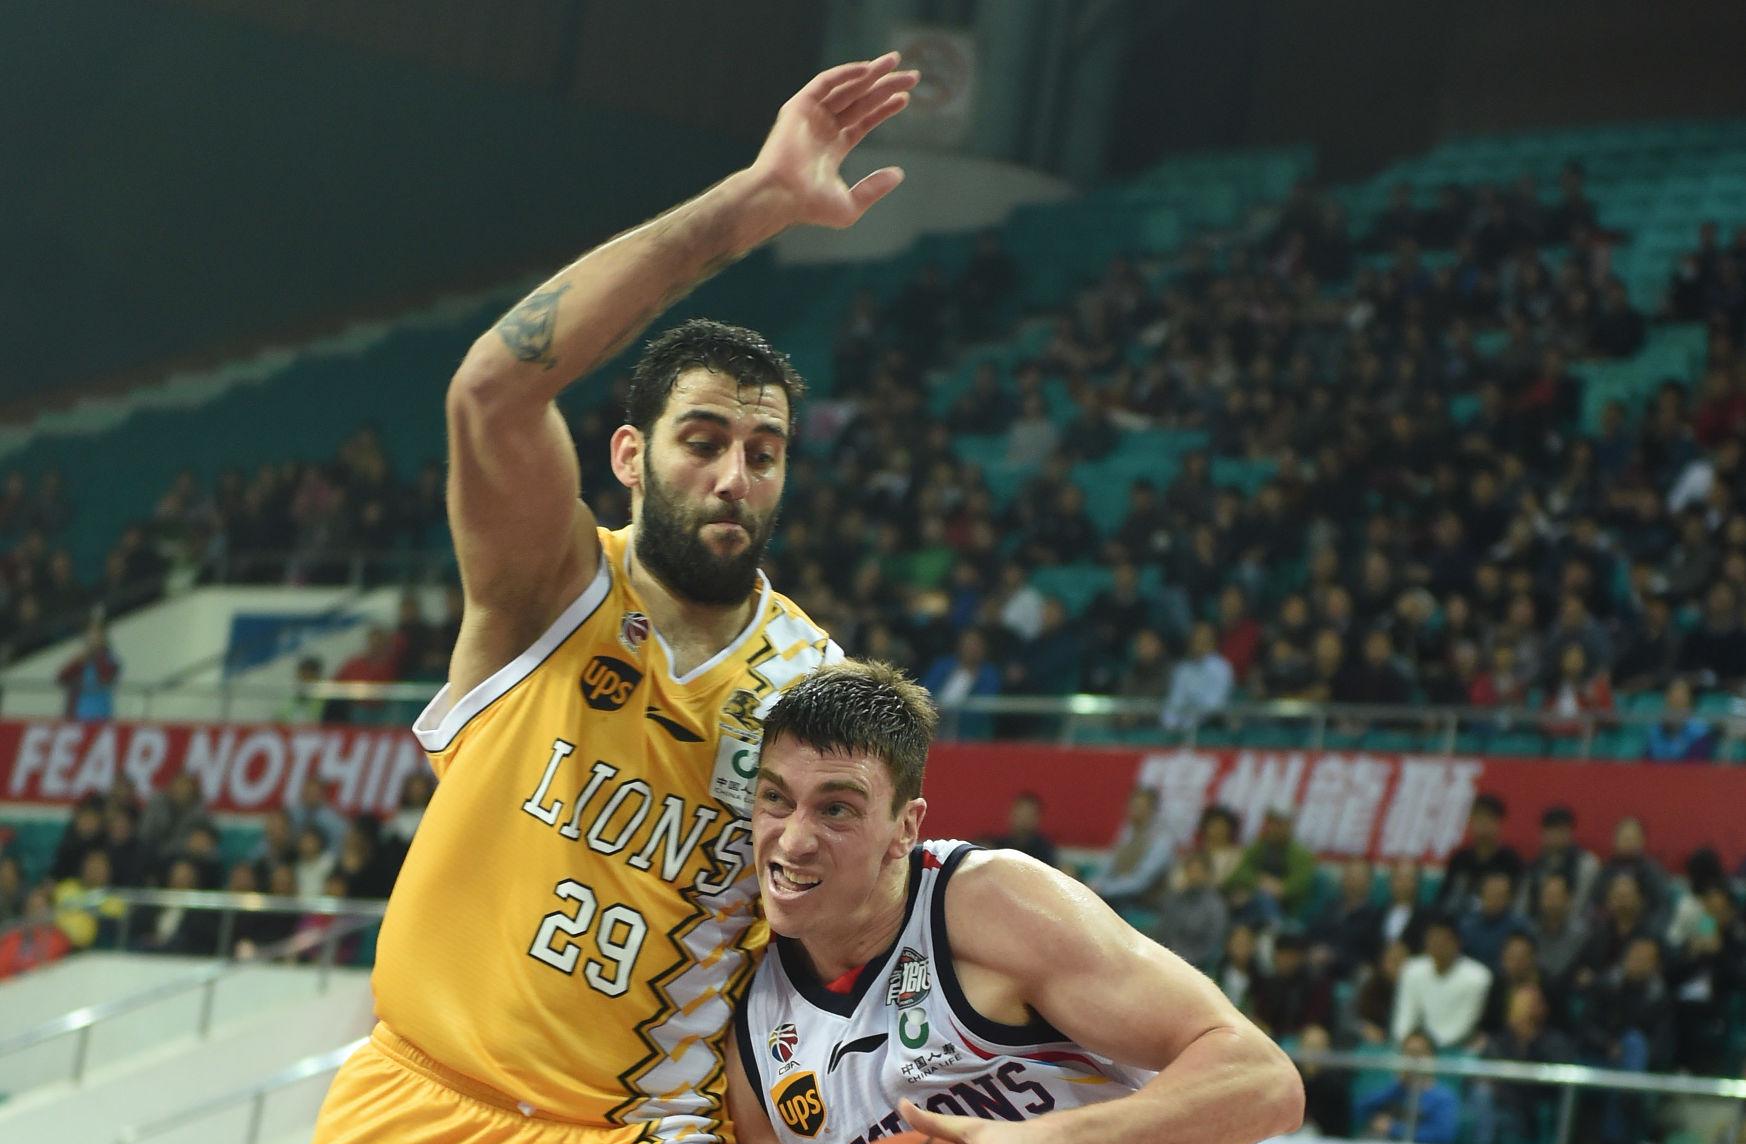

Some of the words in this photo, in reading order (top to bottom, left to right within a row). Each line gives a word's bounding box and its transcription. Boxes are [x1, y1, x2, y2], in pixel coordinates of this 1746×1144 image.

[584, 659, 634, 705] ups
[9, 725, 168, 800] FEAR
[716, 776, 756, 796] 中国人
[522, 738, 753, 897] LIONS
[527, 877, 648, 998] 29
[778, 1060, 801, 1075] CBA
[907, 1065, 938, 1085] CHINA
[938, 1053, 962, 1073] LIFE
[779, 1088, 821, 1131] ups
